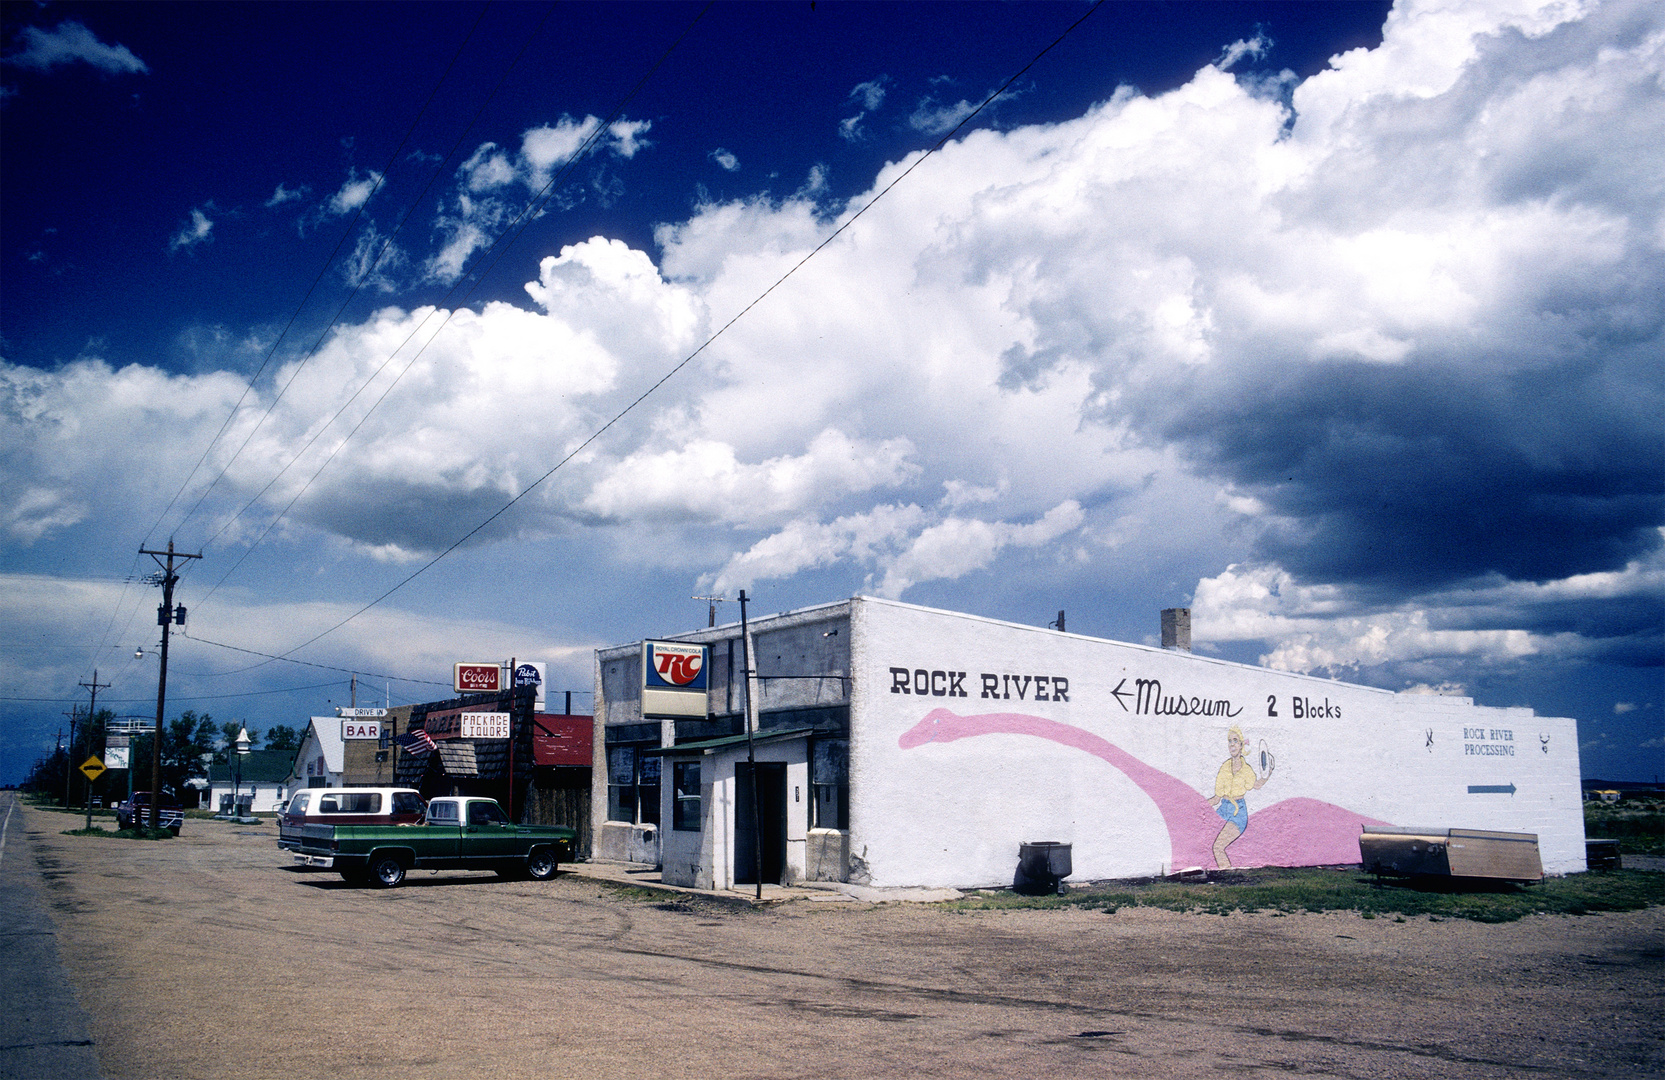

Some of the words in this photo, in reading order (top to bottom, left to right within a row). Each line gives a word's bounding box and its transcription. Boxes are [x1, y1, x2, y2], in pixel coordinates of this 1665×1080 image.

[518, 667, 537, 677] Pabst
[656, 653, 701, 684] RC
[461, 669, 496, 683] Coors
[889, 667, 968, 698] ROCK
[980, 673, 1070, 702] RIVER
[1135, 679, 1244, 719] Museum
[1266, 695, 1278, 717] 2
[1292, 696, 1342, 720] Blocks
[354, 708, 374, 716] DRIVE
[376, 708, 384, 716] IN
[463, 715, 508, 726] PACKAGE
[346, 725, 377, 736] BAR
[463, 726, 508, 737] LIQUORS
[1464, 728, 1485, 740] ROCK
[1490, 729, 1513, 740] RIVER
[1464, 744, 1515, 756] PROCESSING
